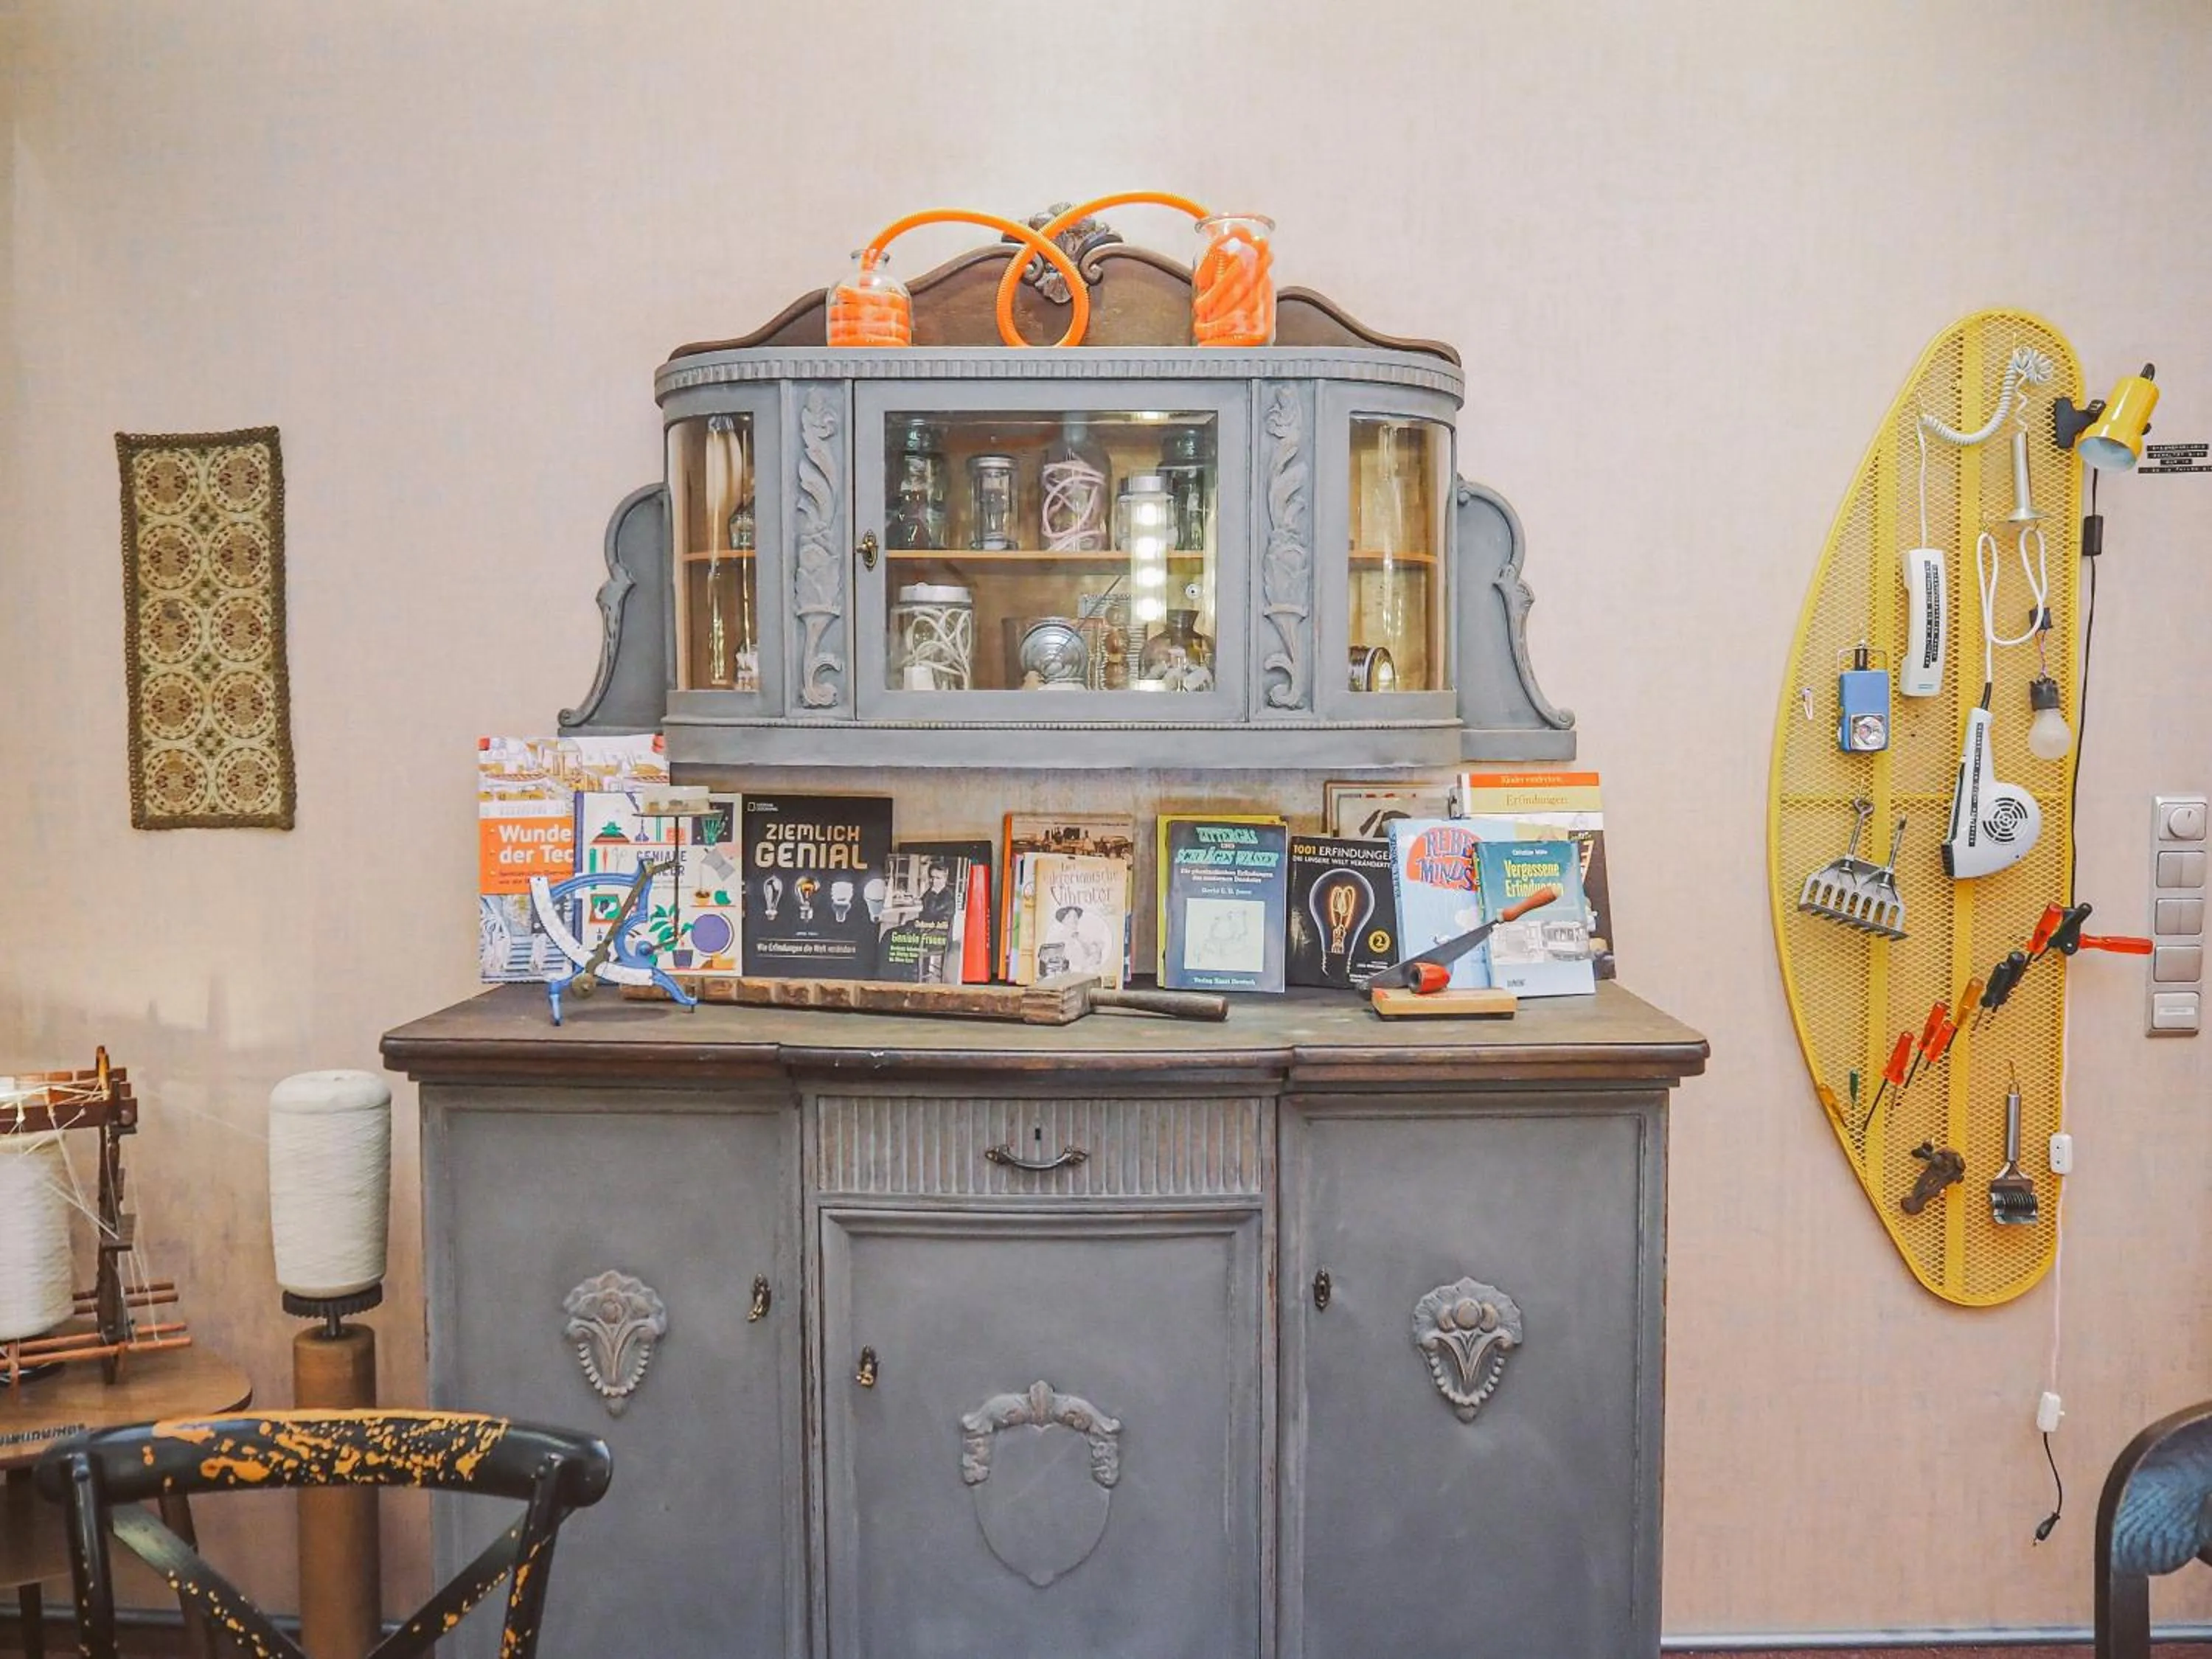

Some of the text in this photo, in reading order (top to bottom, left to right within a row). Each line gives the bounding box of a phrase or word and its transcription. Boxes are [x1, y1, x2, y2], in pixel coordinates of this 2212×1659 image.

[766, 824, 860, 841] ZIEMLICH
[499, 846, 534, 864] der
[636, 850, 687, 862] GENIAE
[755, 841, 868, 869] GENIAL
[1292, 844, 1391, 860] 1001 ERFINDUNGE
[1503, 860, 1560, 880] Vergessene
[1375, 934, 1384, 946] 2
